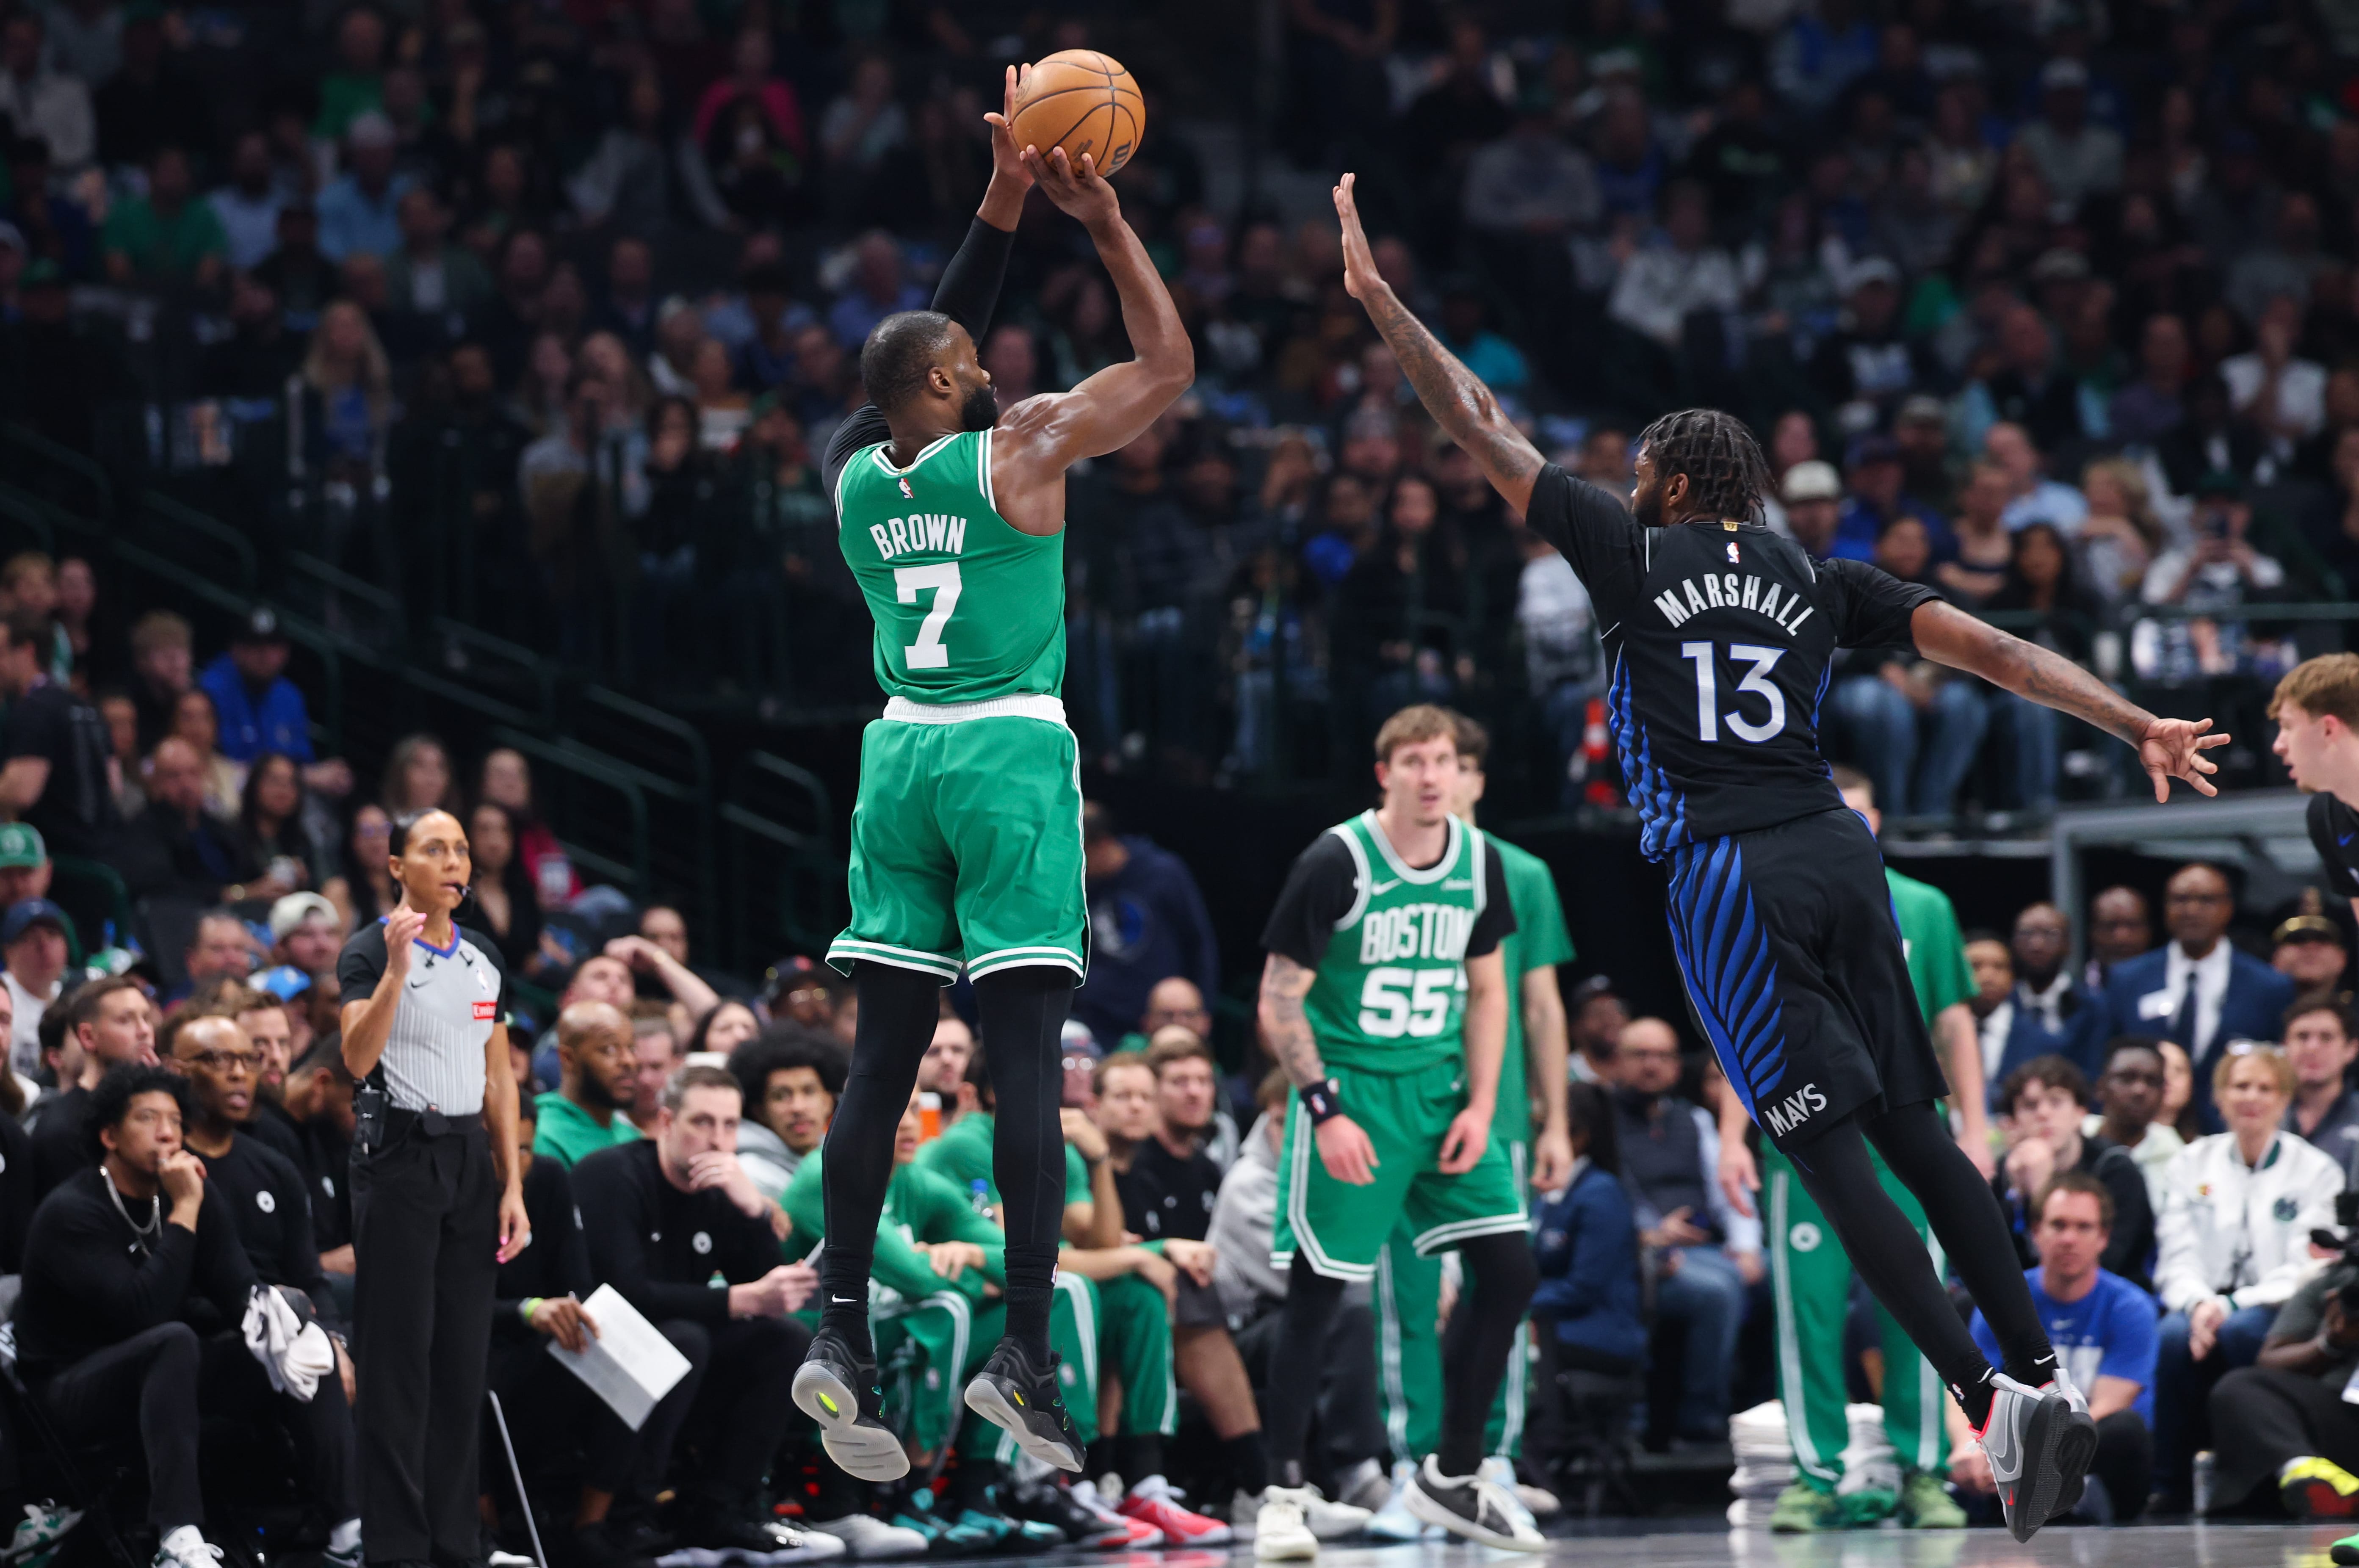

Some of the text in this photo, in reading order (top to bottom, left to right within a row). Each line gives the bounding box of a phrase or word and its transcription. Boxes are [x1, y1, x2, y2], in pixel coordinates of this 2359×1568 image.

[869, 514, 967, 561] BROWN
[893, 561, 962, 669] 7
[1653, 573, 1815, 636] MARSHALL
[1681, 640, 1788, 744] 13
[1359, 902, 1475, 965] BOSTON
[1358, 966, 1455, 1038] 55
[1764, 1083, 1827, 1137] MAVS
